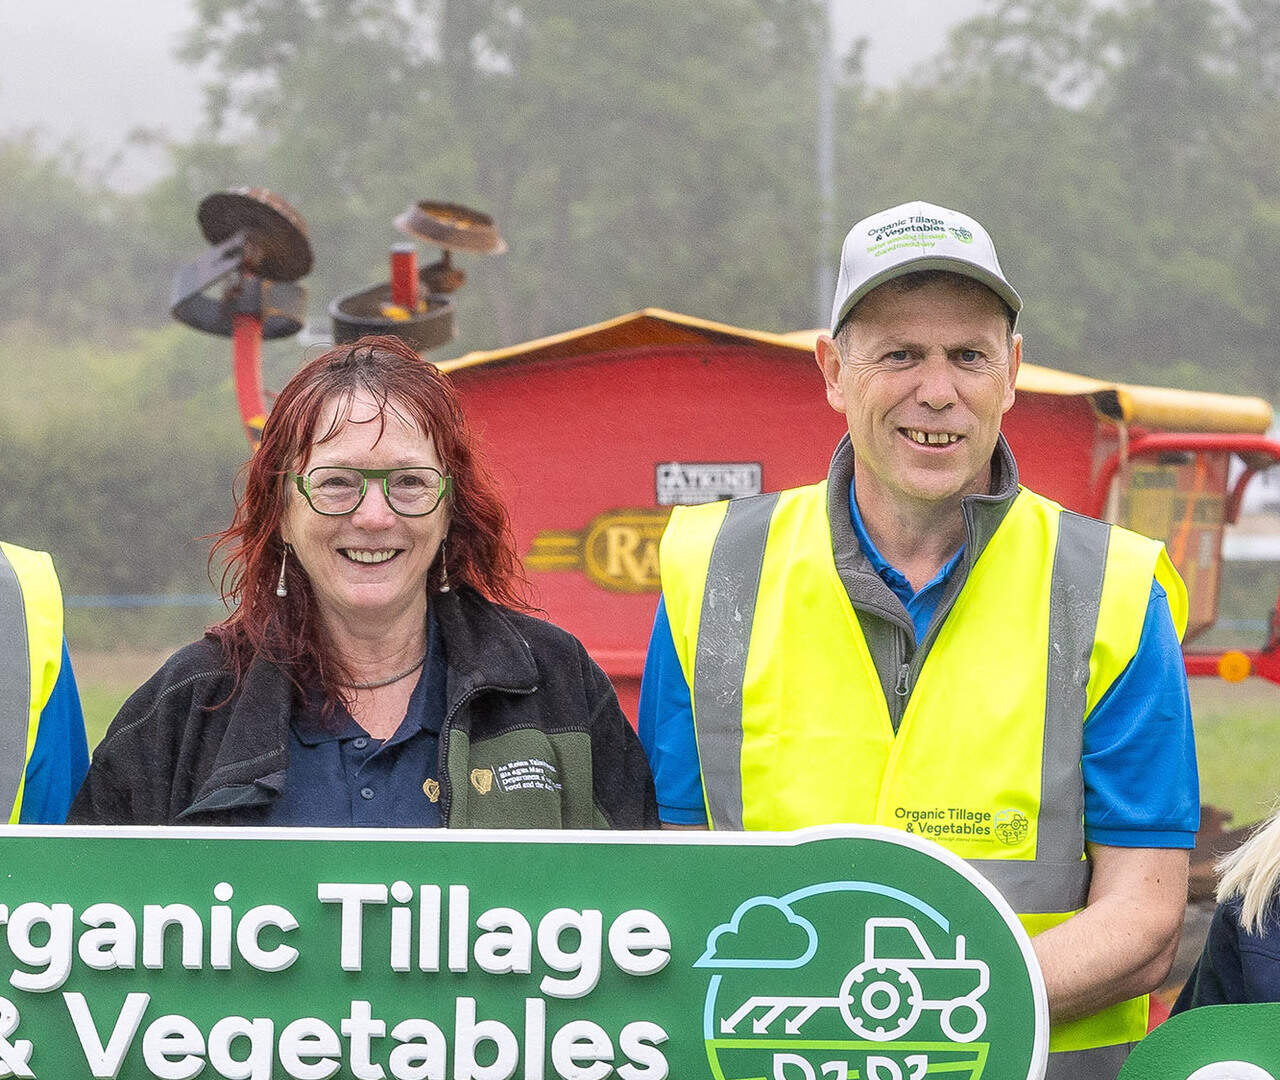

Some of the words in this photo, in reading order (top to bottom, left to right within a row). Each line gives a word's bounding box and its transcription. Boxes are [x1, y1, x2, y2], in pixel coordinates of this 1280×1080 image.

[867, 218, 906, 237] Organic
[908, 216, 945, 226] Tillage
[884, 224, 946, 239] Vegetables
[895, 807, 945, 821] Organic
[948, 808, 991, 823] Tillage
[906, 822, 914, 833] &
[918, 822, 991, 836] Vegetables
[317, 880, 672, 999] Tillage
